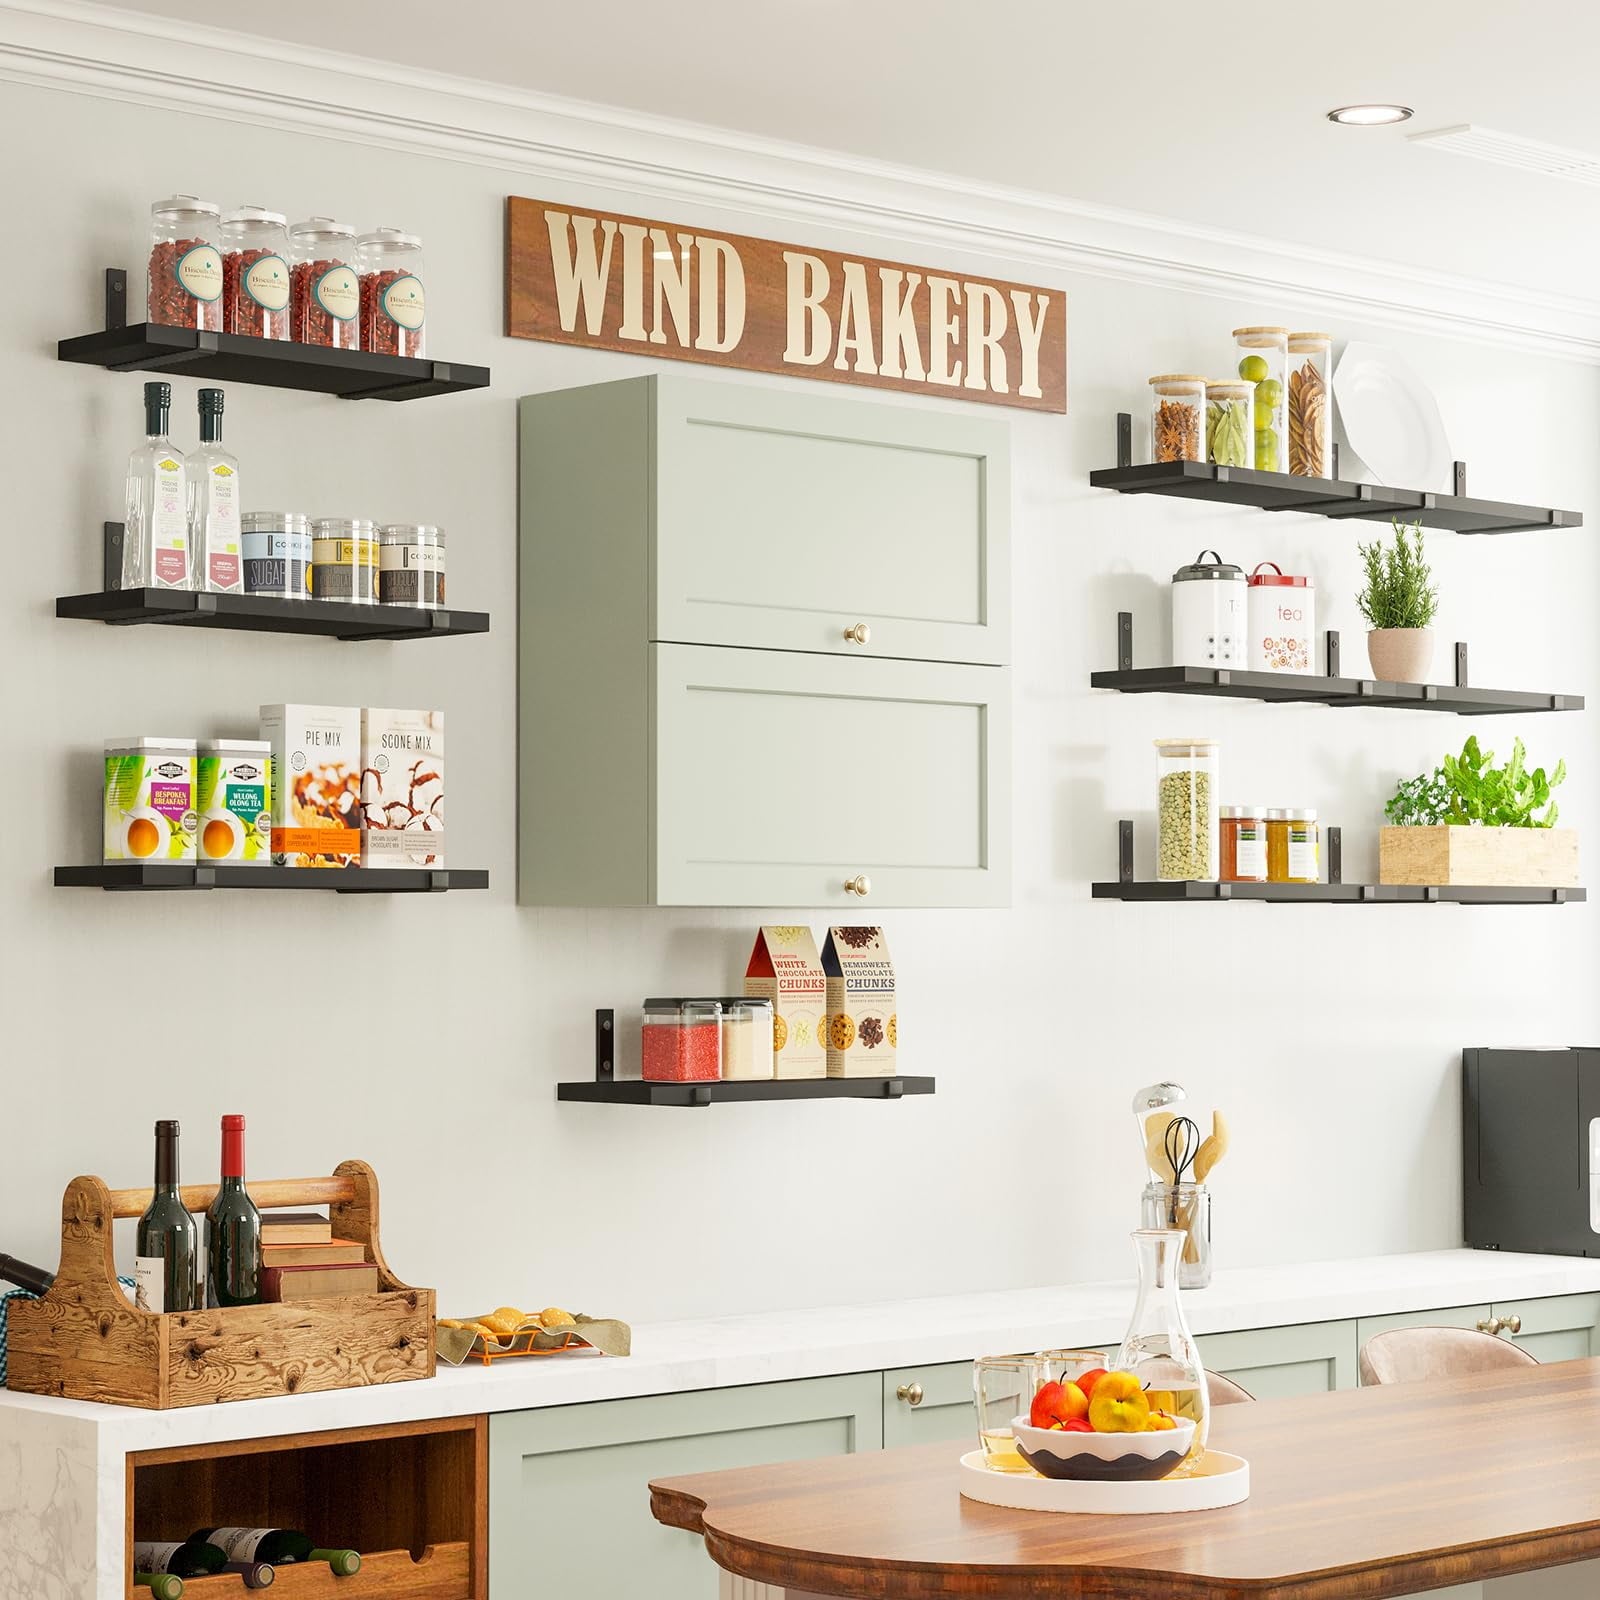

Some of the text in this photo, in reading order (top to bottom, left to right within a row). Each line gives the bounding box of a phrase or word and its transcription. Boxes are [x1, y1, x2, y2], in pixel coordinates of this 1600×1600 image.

[544, 210, 1050, 399] WIND BAKERY
[1278, 604, 1302, 621] tea
[306, 731, 341, 746] PIE MIX
[382, 734, 431, 750] SCONE MIX
[155, 790, 186, 798] BESPOKEN
[780, 979, 825, 989] CHUNKS
[846, 978, 895, 989] CHUNKS
